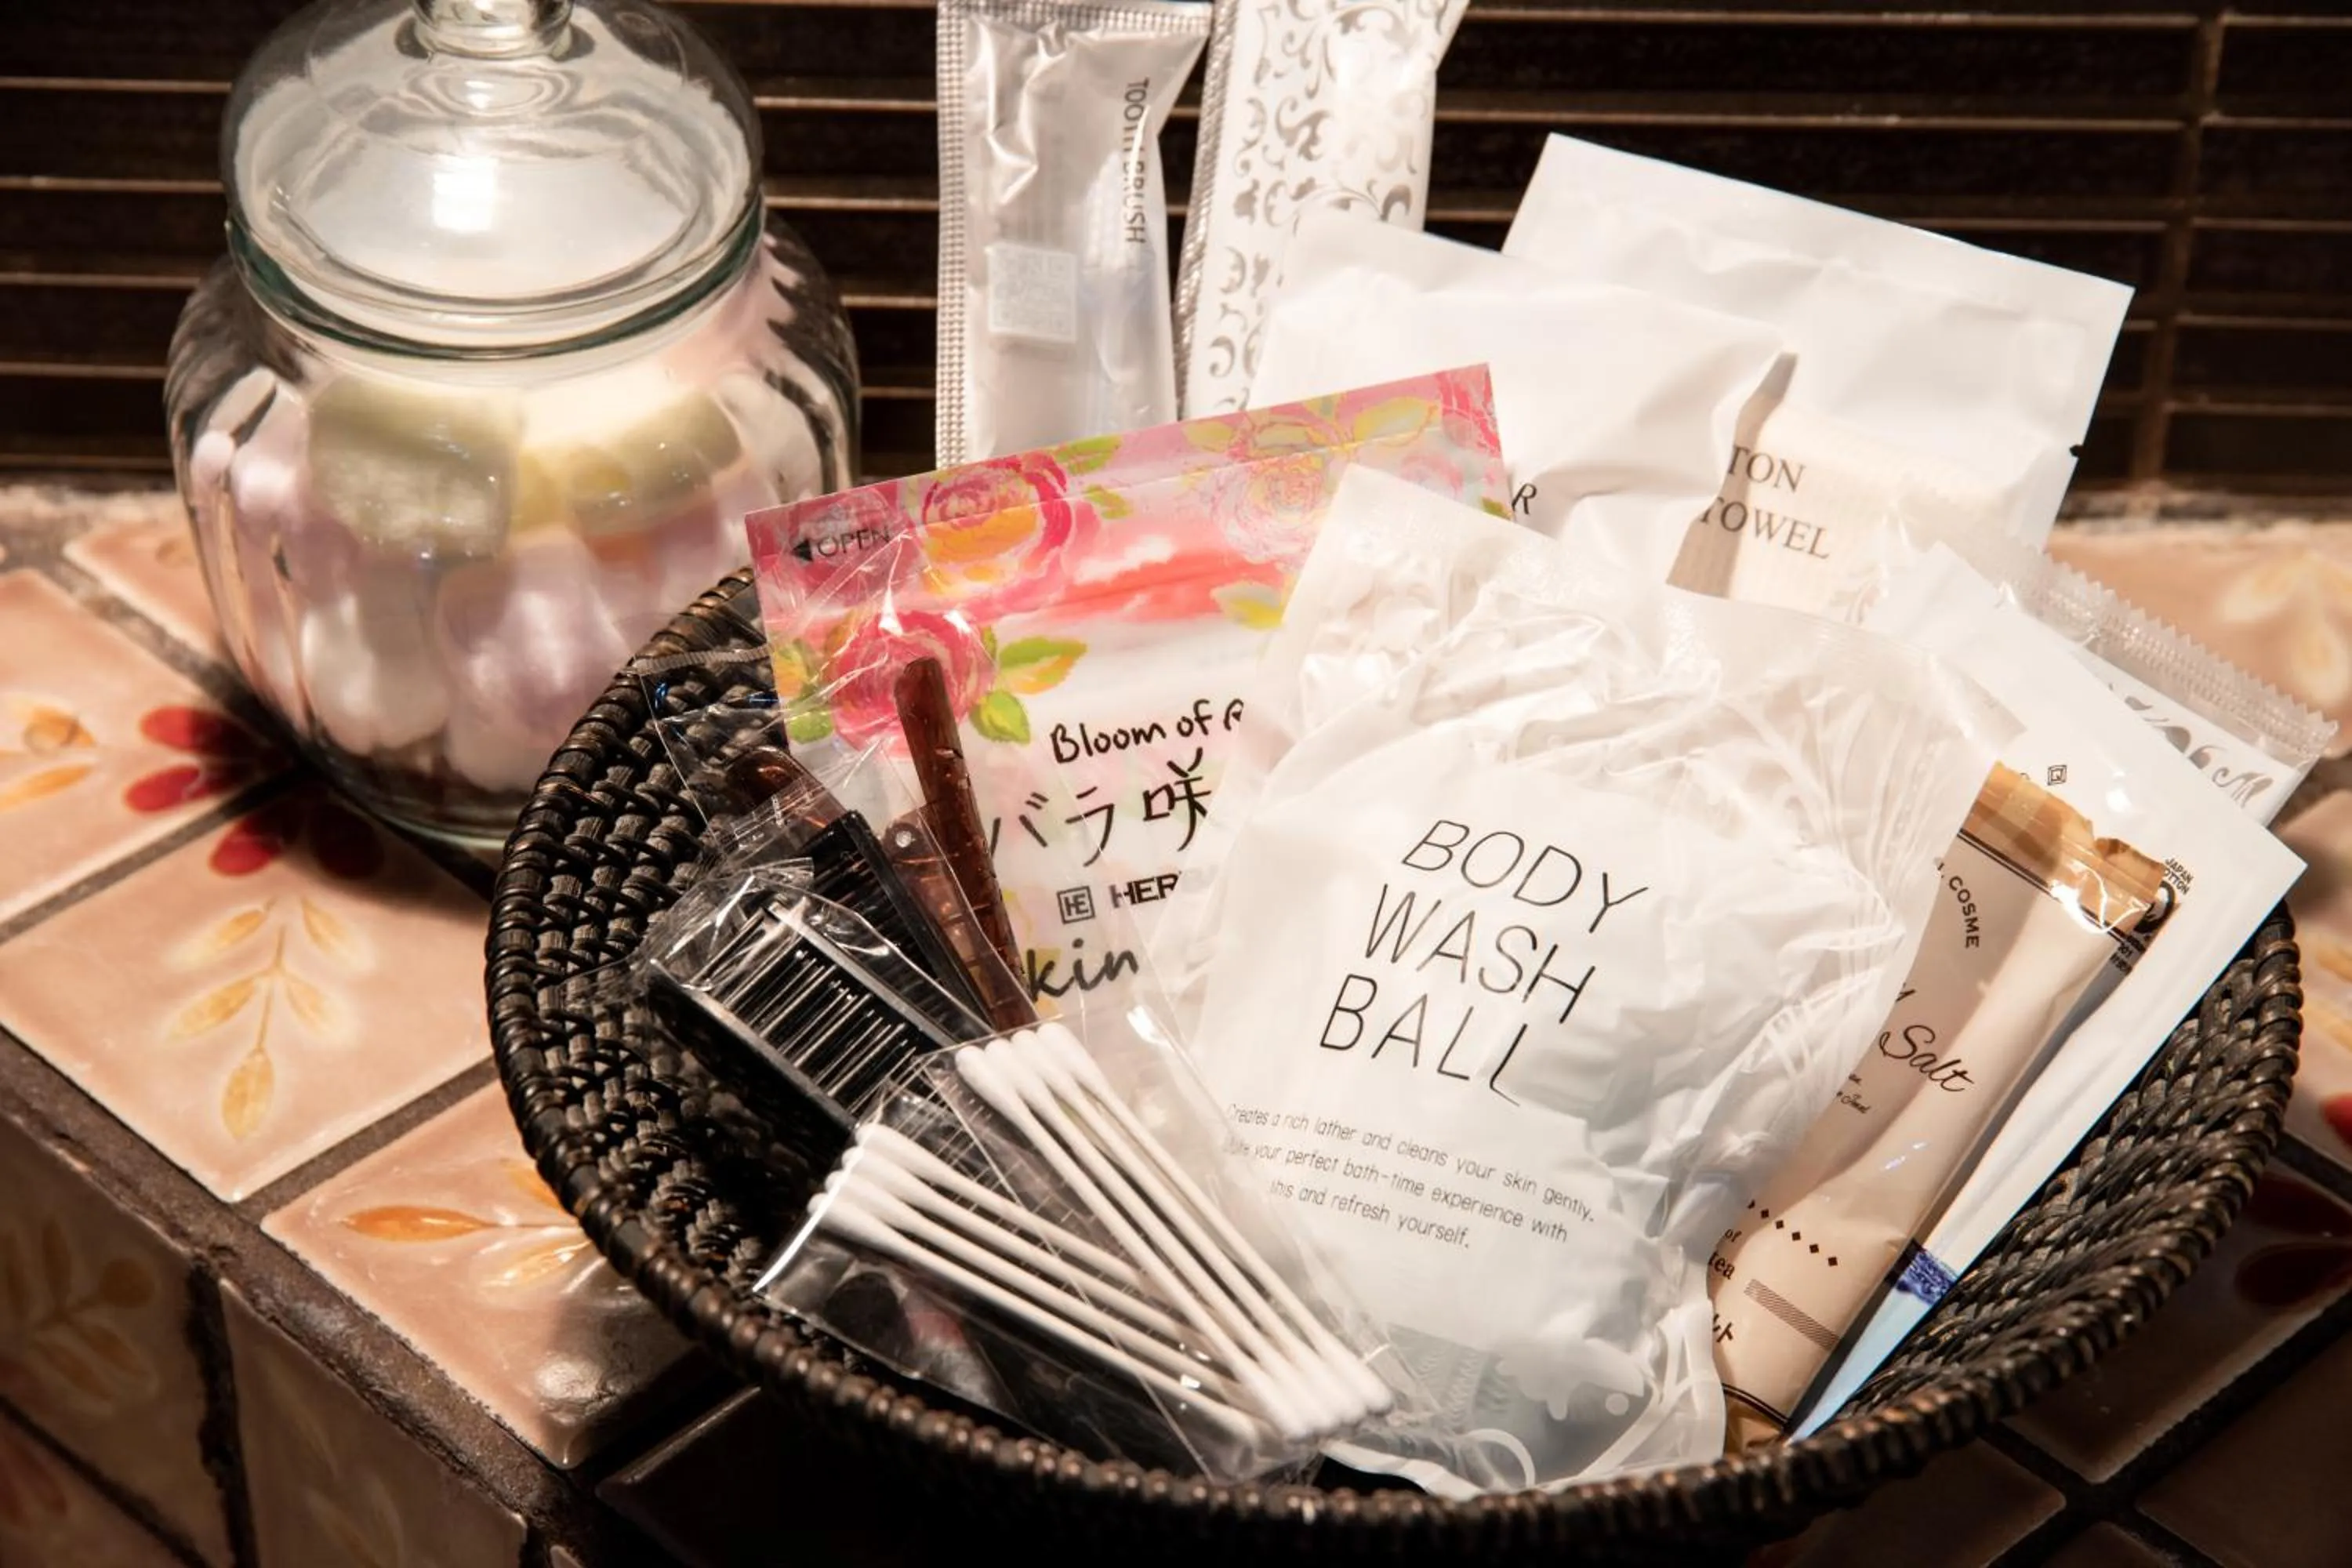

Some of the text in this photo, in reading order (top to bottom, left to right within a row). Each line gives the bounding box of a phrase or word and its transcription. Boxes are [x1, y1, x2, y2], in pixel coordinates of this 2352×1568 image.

[1049, 723, 1167, 764] Bloom
[1176, 699, 1212, 737] of
[1402, 820, 1649, 933] BODY
[1948, 875, 1980, 949] COSME
[2165, 858, 2194, 885] JAPAN
[1366, 883, 1596, 1024] WASH
[1319, 974, 1528, 1107] BALL
[1878, 1024, 1976, 1092] Salt
[1271, 1114, 1281, 1127] a
[1283, 1112, 1309, 1132] rich
[1315, 1116, 1358, 1142] lather
[1362, 1131, 1392, 1152] and
[1396, 1138, 1450, 1167] cleans
[1456, 1157, 1497, 1181] your
[1502, 1170, 1537, 1196] skin
[1542, 1187, 1595, 1223] gently.
[1286, 1149, 1339, 1174] perfect
[1343, 1157, 1426, 1198] bath-time
[1432, 1186, 1524, 1229] experience
[1531, 1218, 1569, 1245] with
[1299, 1185, 1328, 1207] and
[1330, 1192, 1391, 1223] refresh
[1396, 1214, 1471, 1250] yourself.
